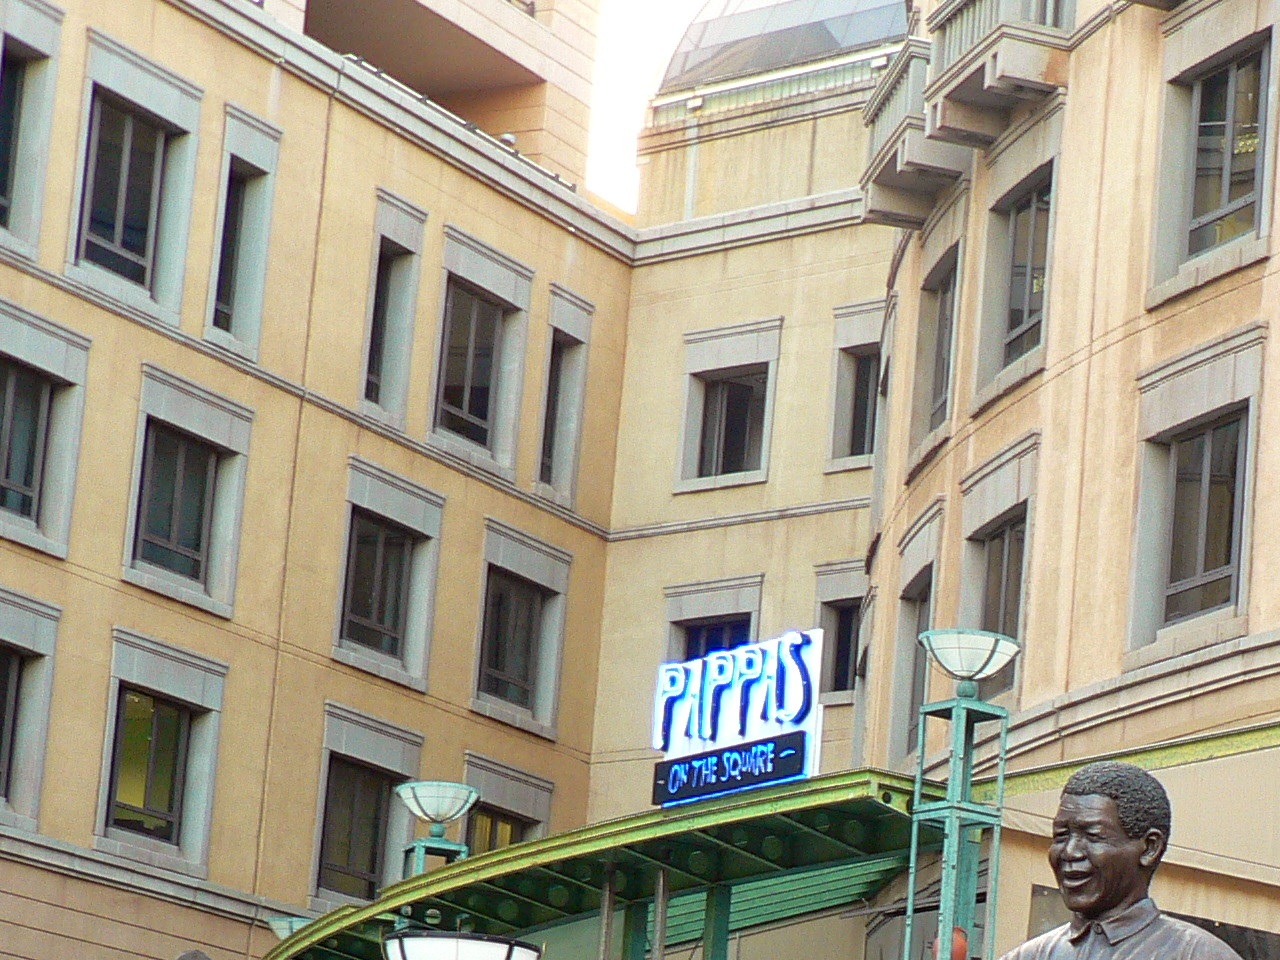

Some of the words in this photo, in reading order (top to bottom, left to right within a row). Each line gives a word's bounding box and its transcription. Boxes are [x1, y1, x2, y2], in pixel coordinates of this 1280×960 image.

[654, 631, 813, 751] PAPPAS
[668, 764, 689, 793] ON
[691, 755, 719, 788] THE
[720, 743, 775, 780] SQUARE
